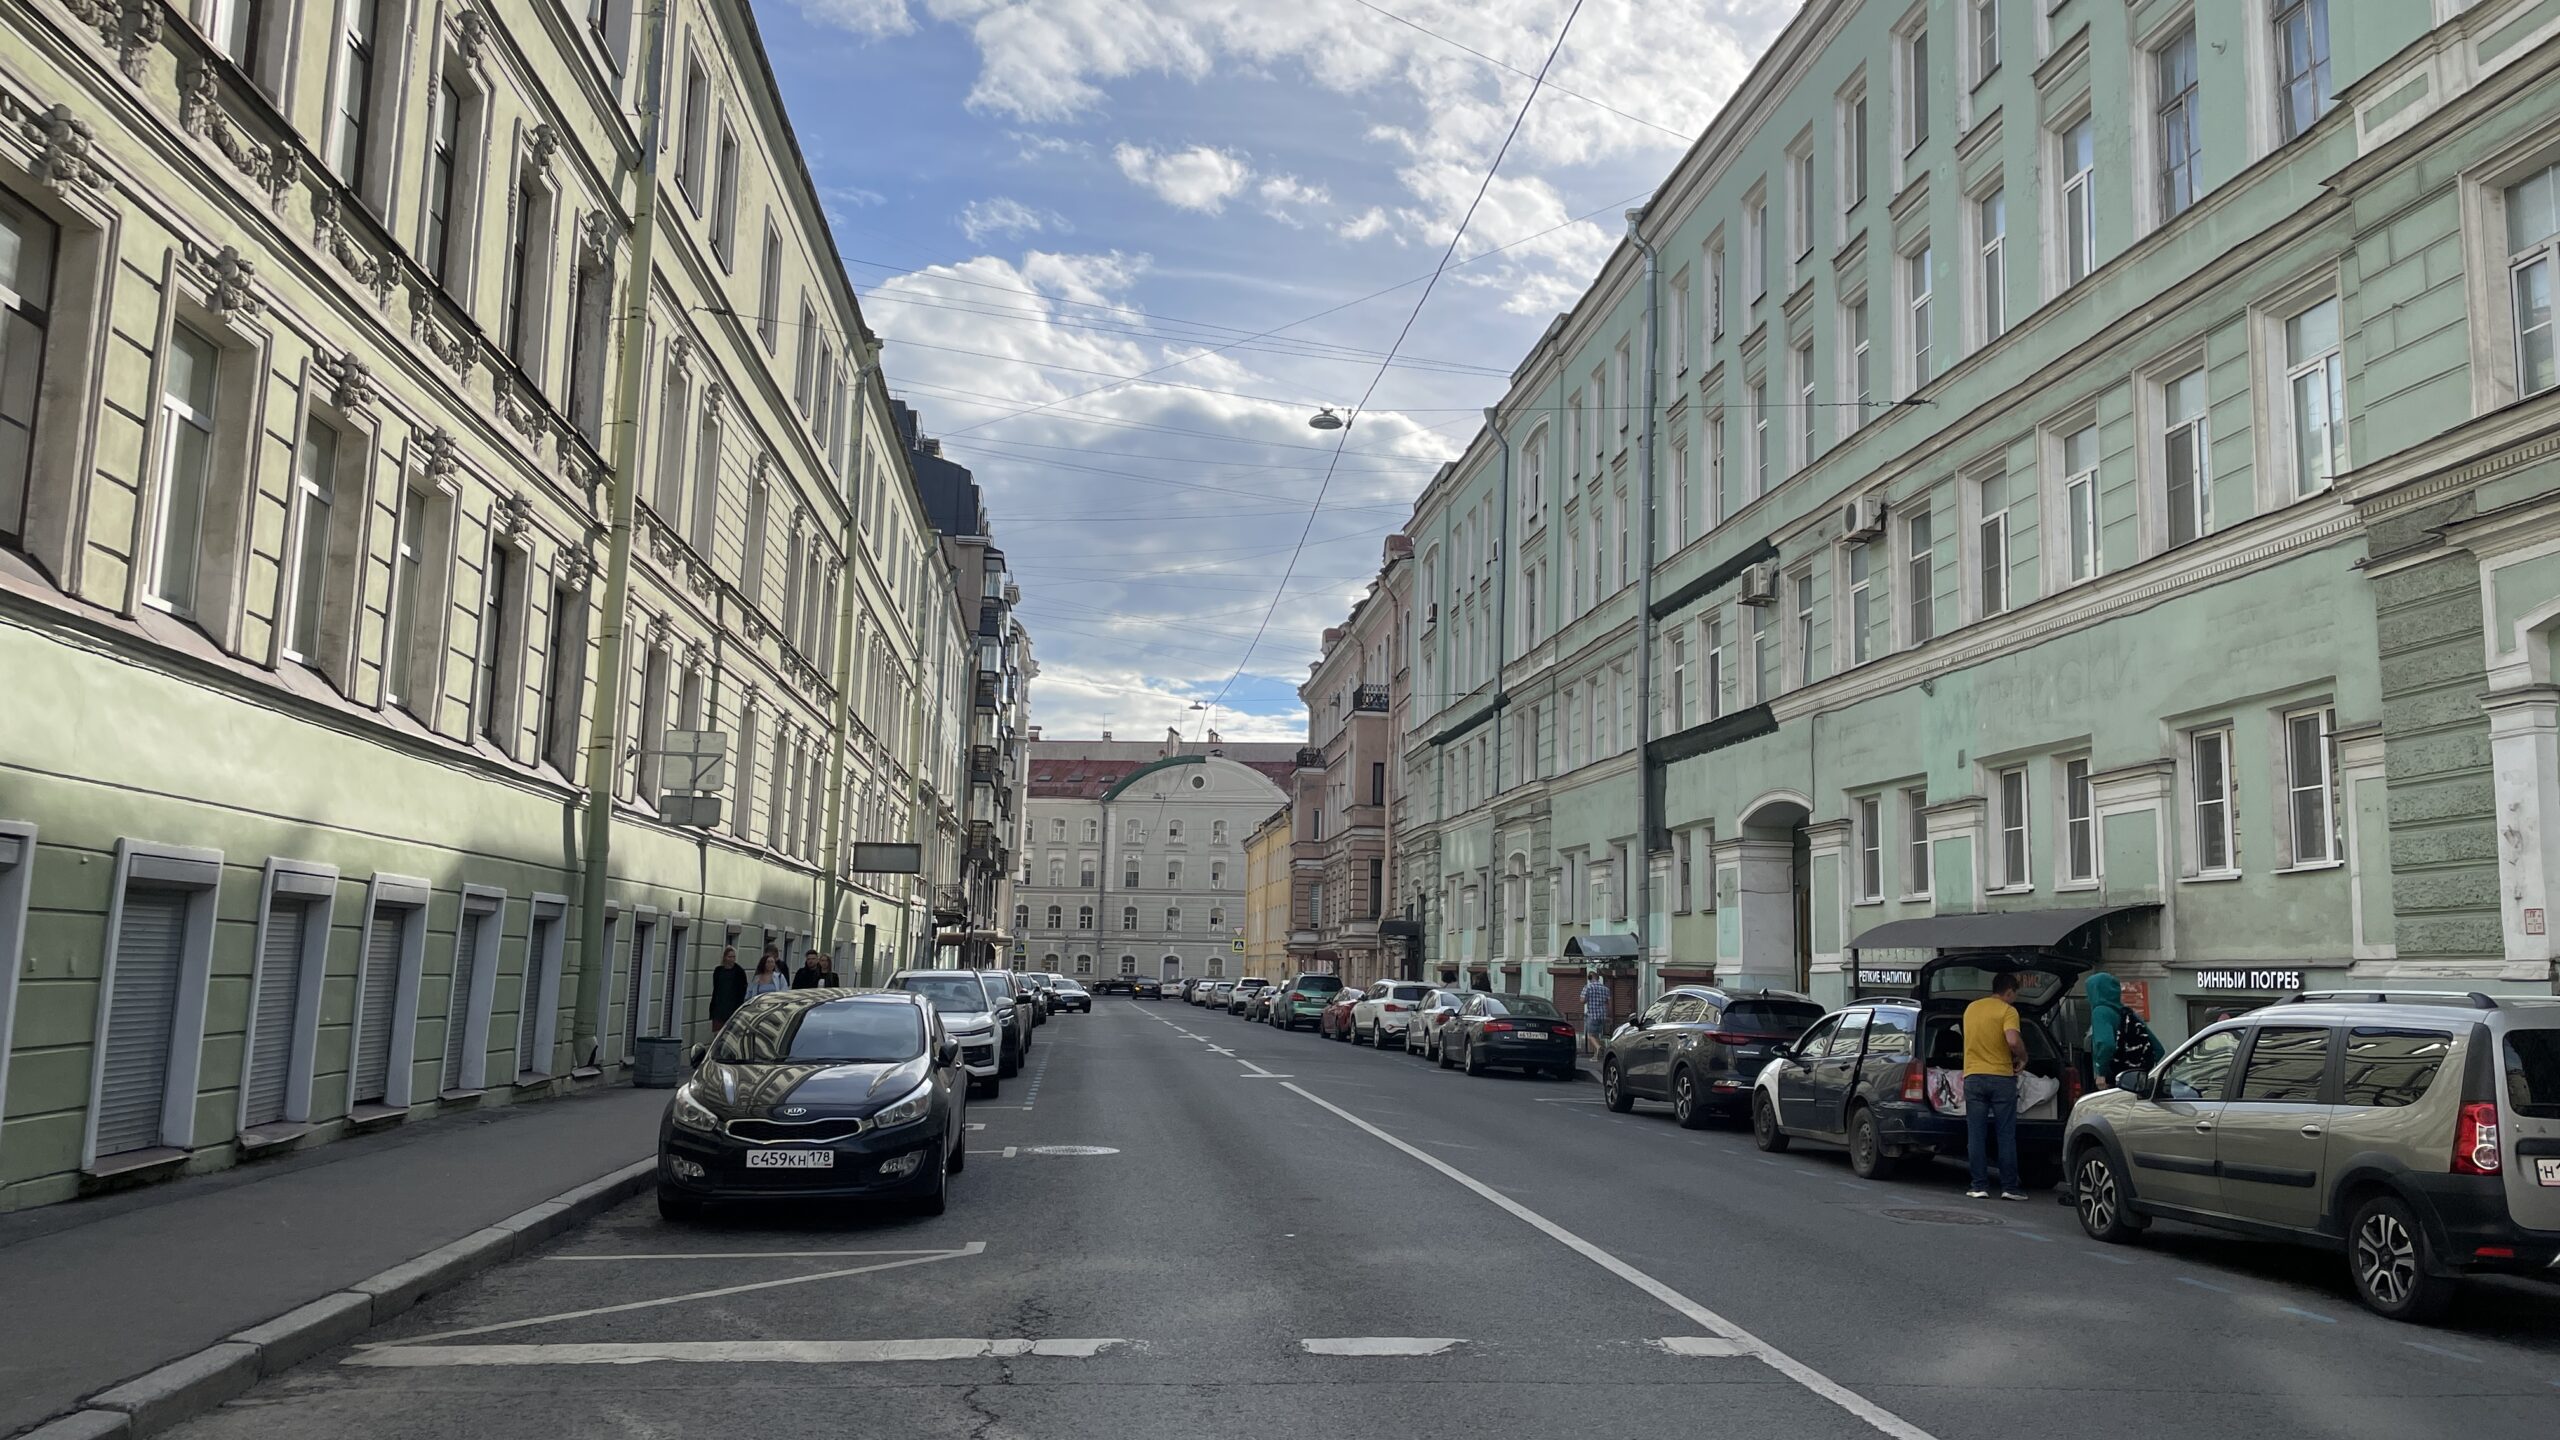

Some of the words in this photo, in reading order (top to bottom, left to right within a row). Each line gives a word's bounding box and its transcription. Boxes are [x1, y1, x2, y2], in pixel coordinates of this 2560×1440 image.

[1859, 970, 1880, 983] РЕПКИЕ
[1881, 971, 1912, 984] НАПИТКИ
[2250, 971, 2300, 990] ПОГРЕБ
[787, 1107, 804, 1115] KIA
[751, 1152, 807, 1166] С459КН
[809, 1151, 830, 1163] 178
